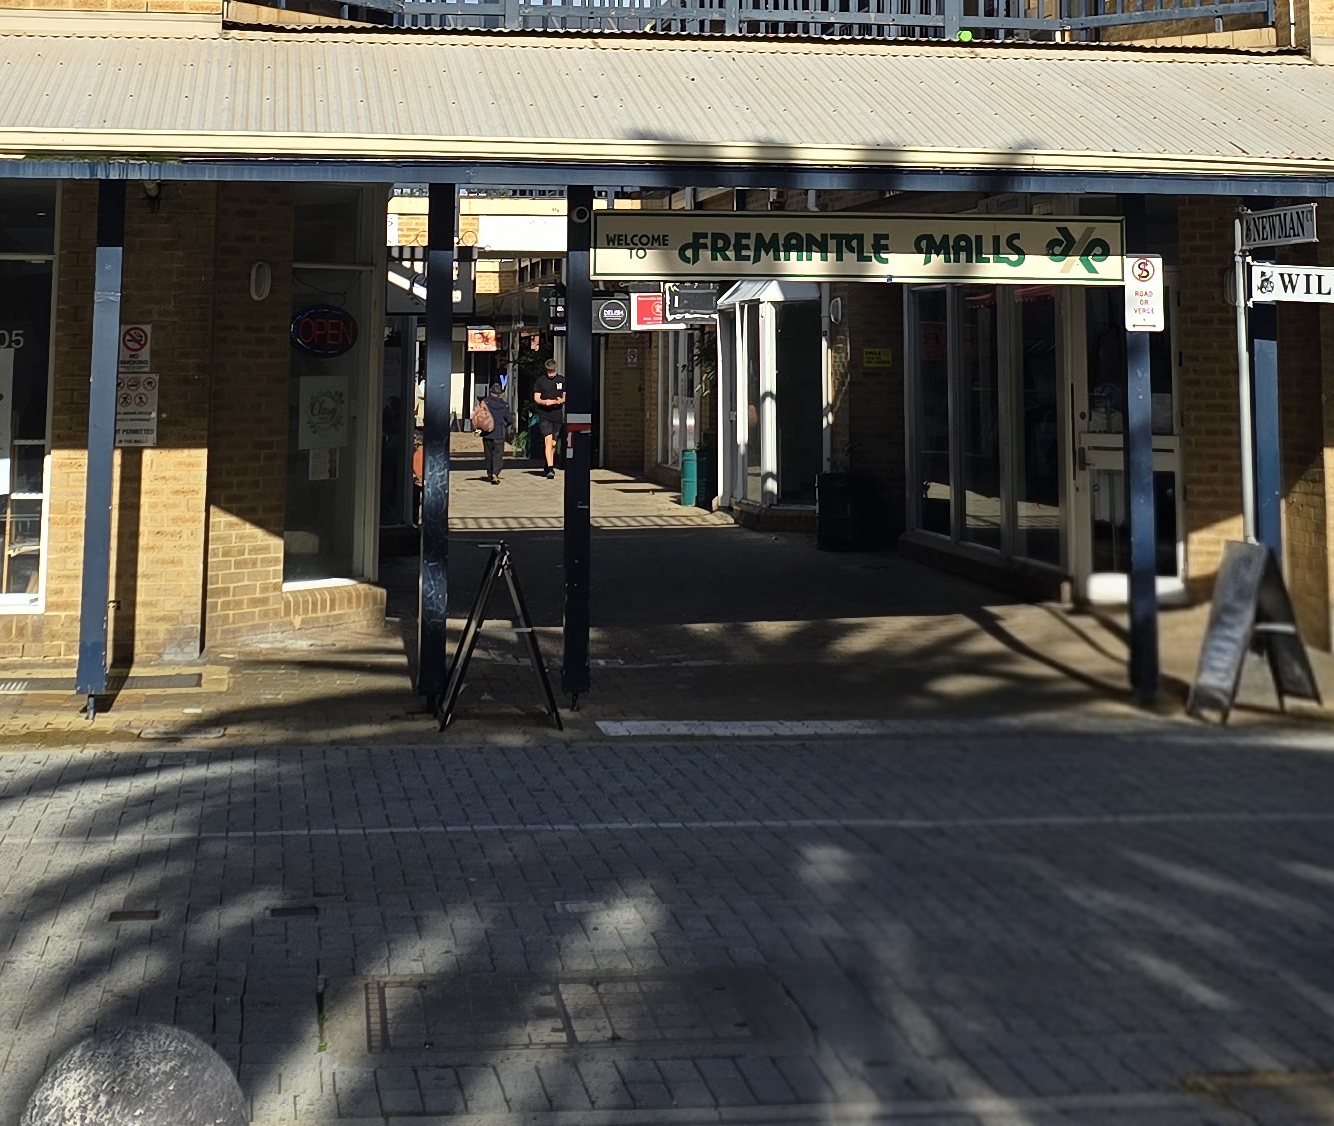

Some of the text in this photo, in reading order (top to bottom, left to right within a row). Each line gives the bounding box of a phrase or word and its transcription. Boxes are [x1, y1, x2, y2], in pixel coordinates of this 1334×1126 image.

[1252, 210, 1306, 243] NEWMAN
[605, 233, 669, 247] WELCOME
[678, 231, 1026, 268] FREMANTLE MALLS
[627, 247, 648, 260] TO
[1134, 307, 1155, 315] VERGE
[298, 317, 354, 346] OPEN
